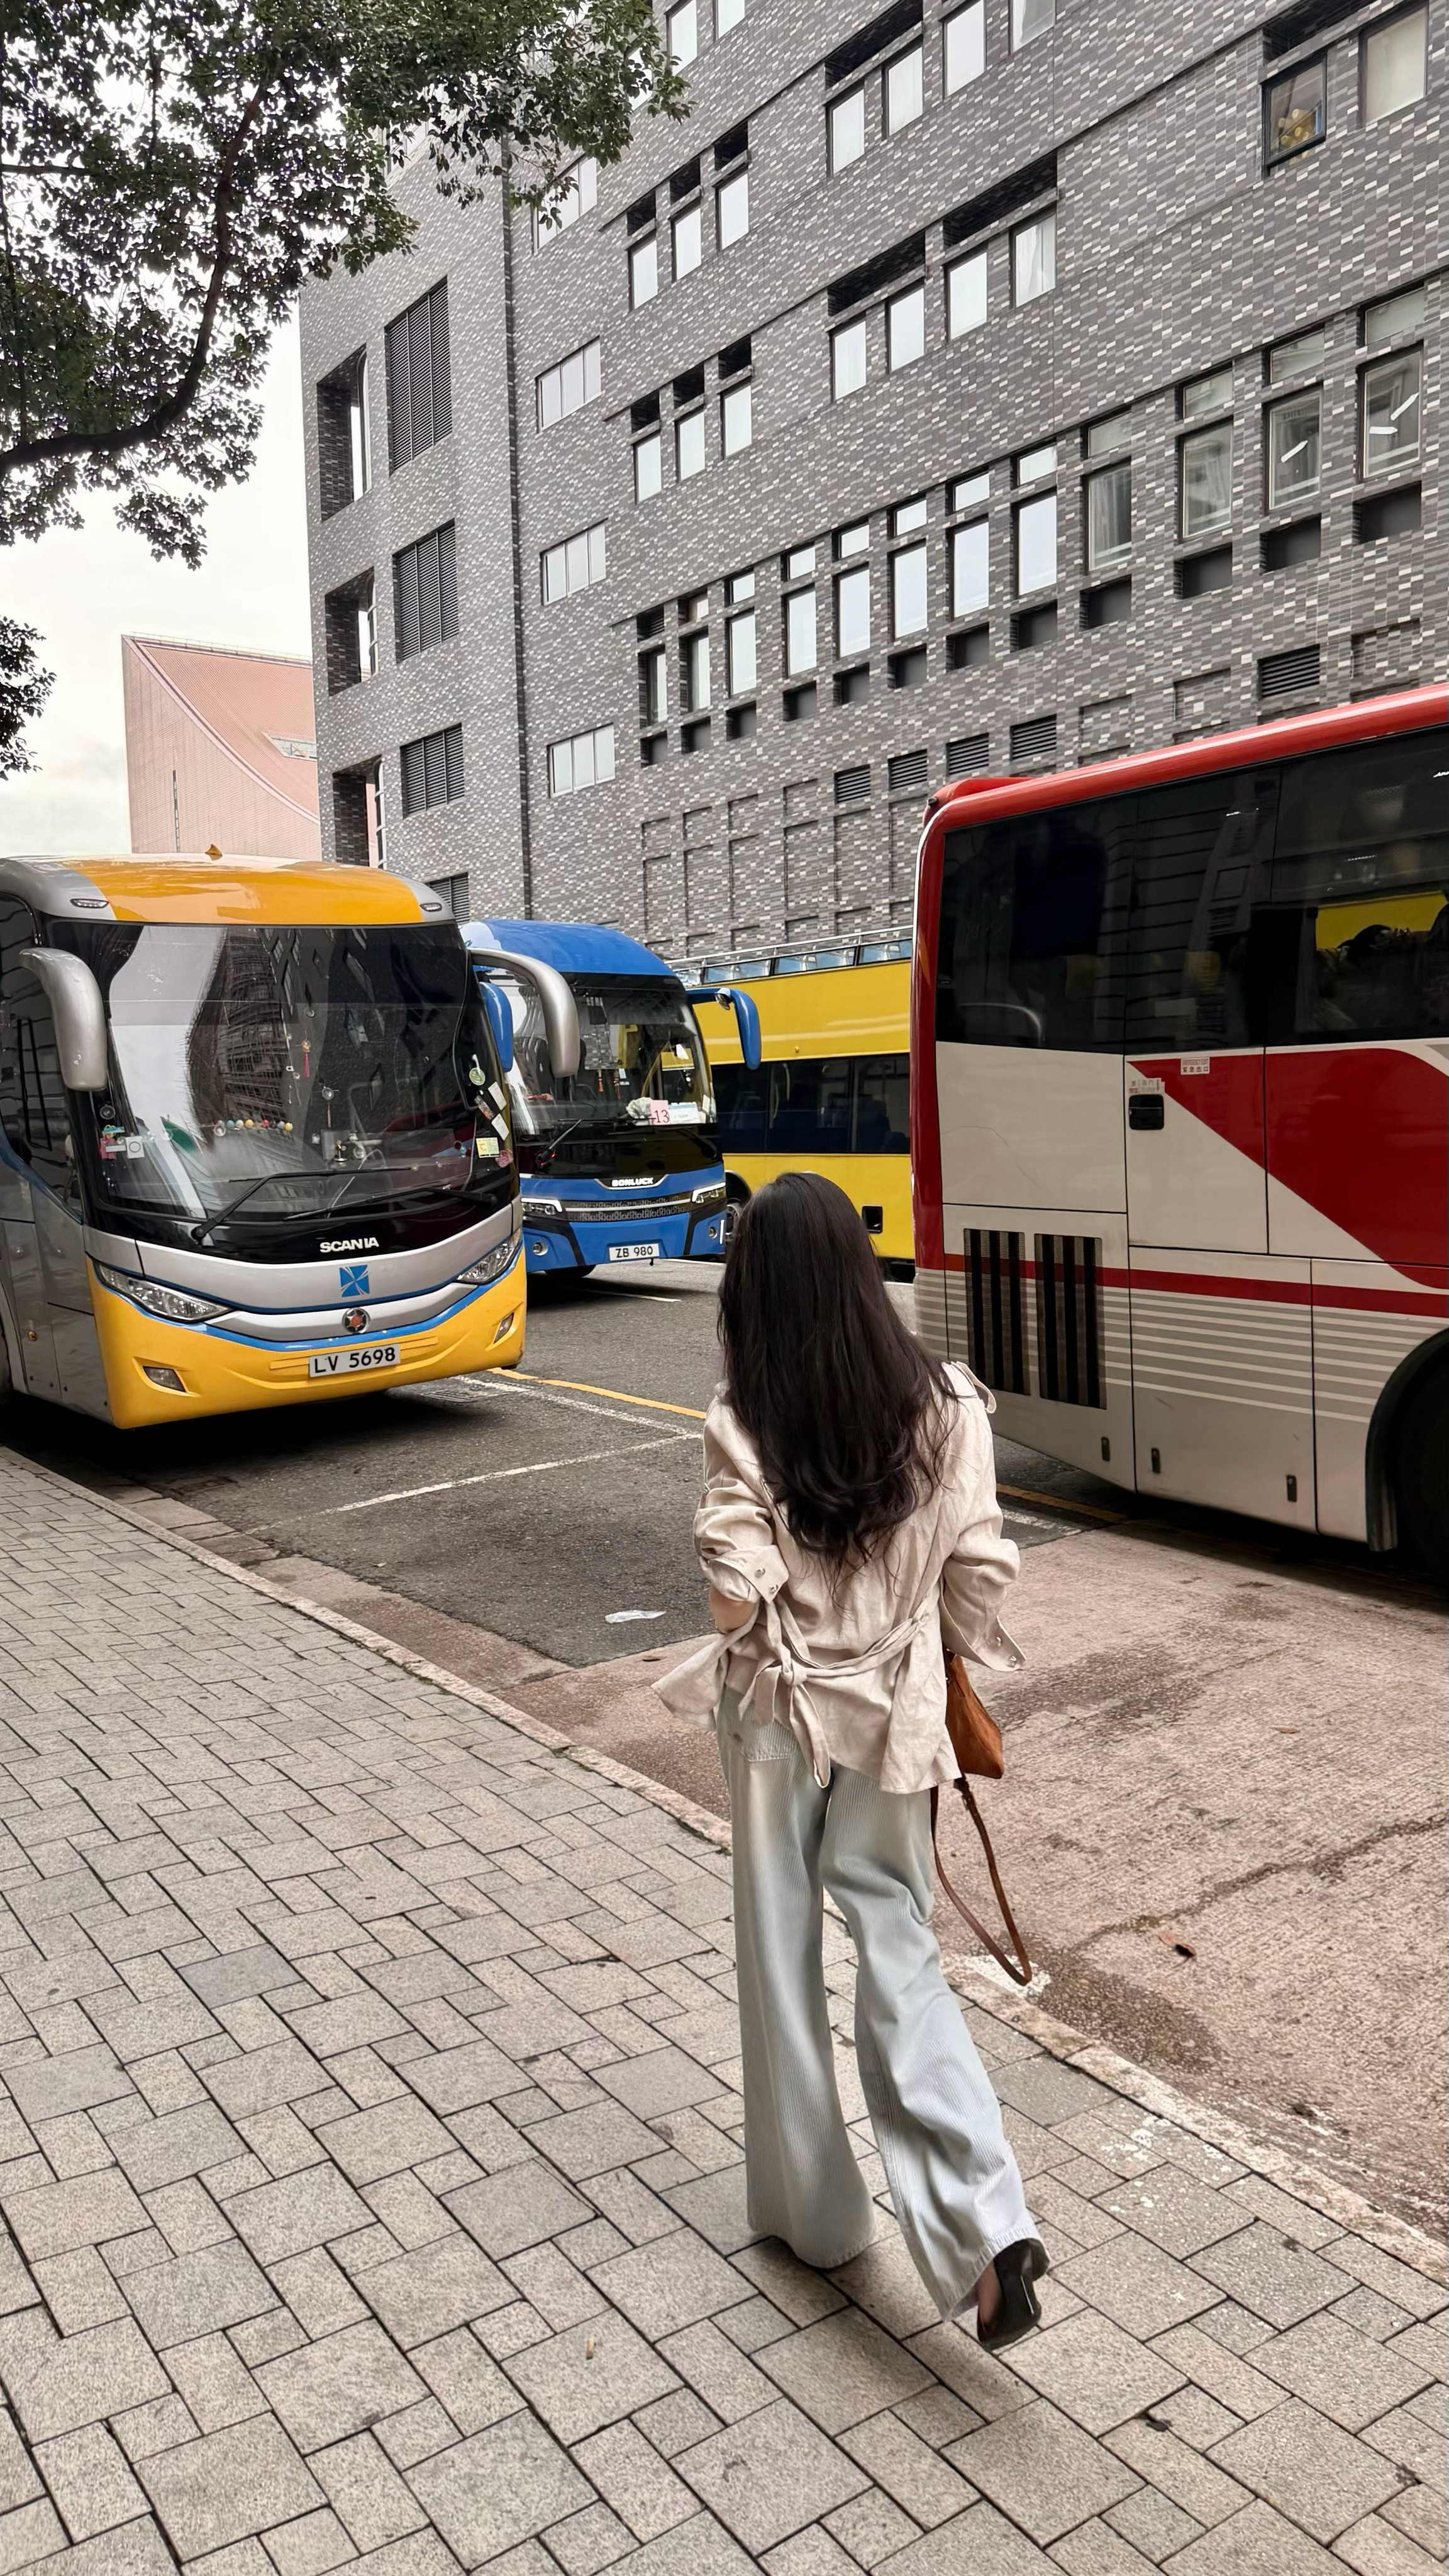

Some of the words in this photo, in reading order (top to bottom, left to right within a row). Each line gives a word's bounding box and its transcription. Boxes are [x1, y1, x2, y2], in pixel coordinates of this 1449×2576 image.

[653, 1109, 670, 1123] 13
[612, 1177, 653, 1187] BONLUCK
[319, 1237, 379, 1253] SCANIA
[616, 1248, 629, 1258] ZB
[634, 1246, 653, 1257] 980
[314, 1356, 338, 1374] LV
[349, 1347, 396, 1368] 5698
